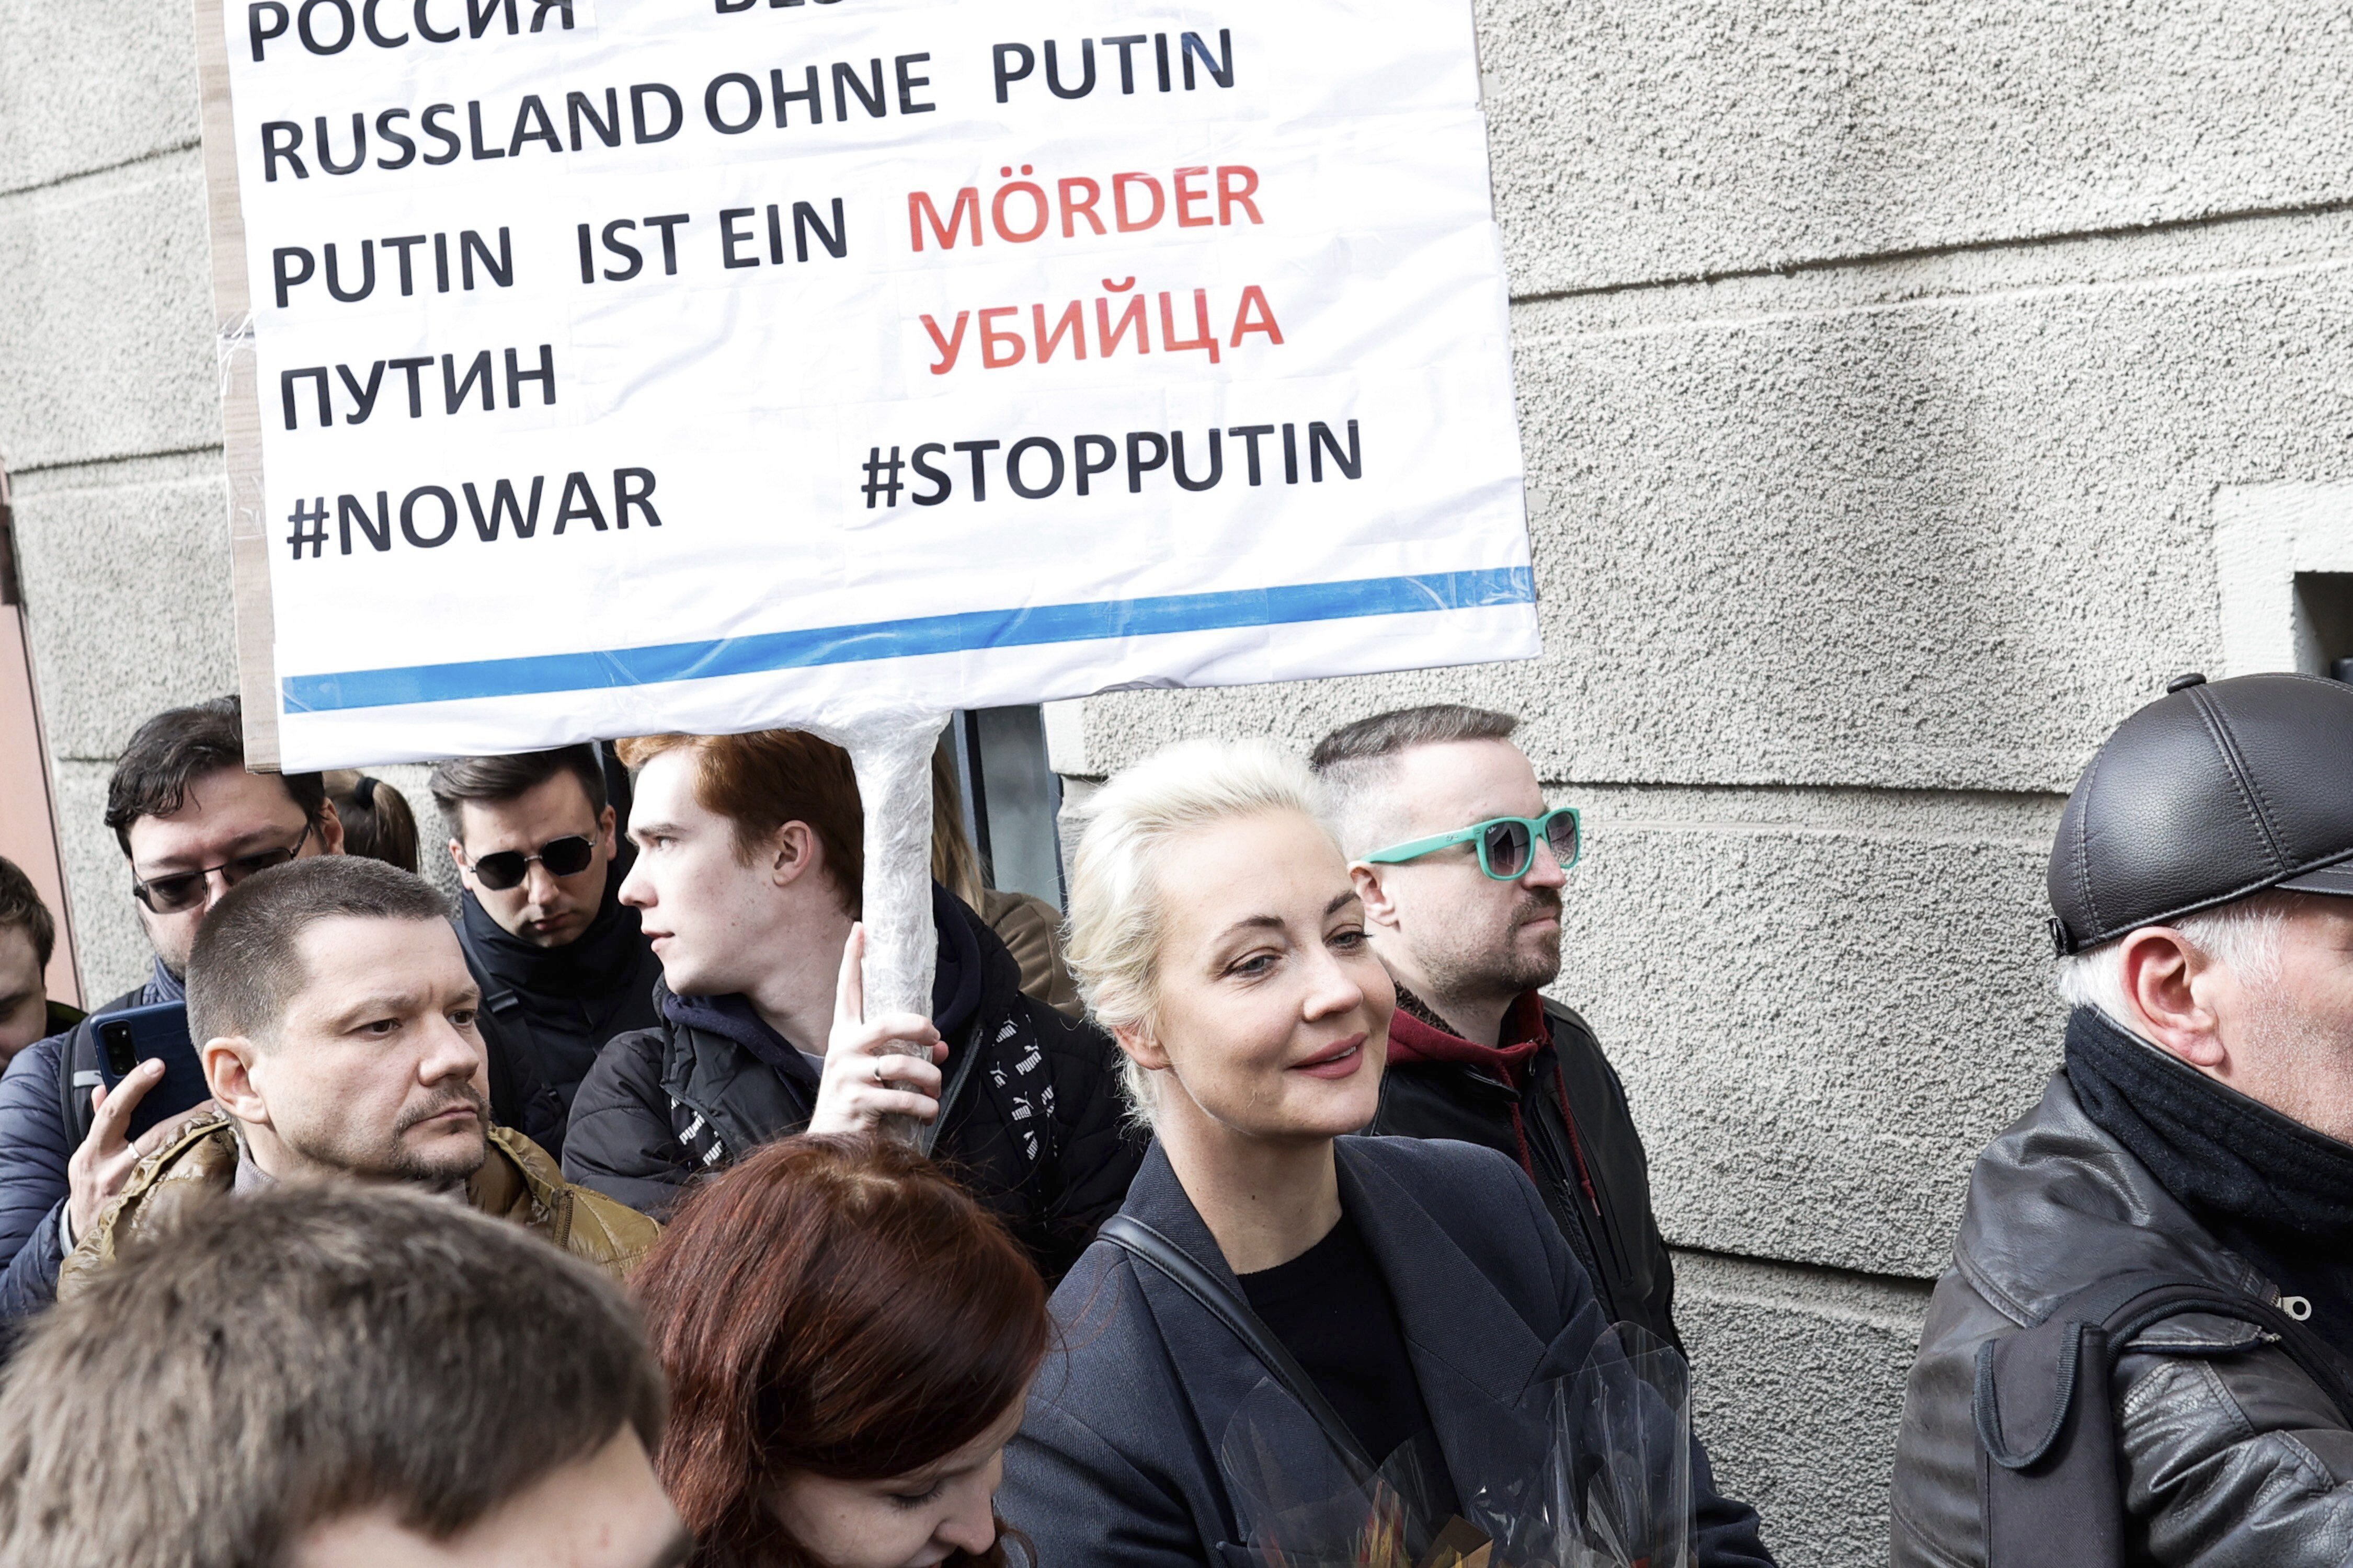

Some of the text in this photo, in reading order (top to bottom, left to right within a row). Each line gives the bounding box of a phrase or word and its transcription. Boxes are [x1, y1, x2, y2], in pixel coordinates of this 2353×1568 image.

[261, 28, 1234, 182] RUSSLAND OHNE PUTIN
[273, 164, 1264, 308] PUTIN IST EIN MÖRDER
[281, 276, 1284, 430] ПУТИН УБИЙЦА
[287, 419, 1362, 560] #NOWAR #STOPPUTIN
[1015, 1050, 1042, 1076] PUMA
